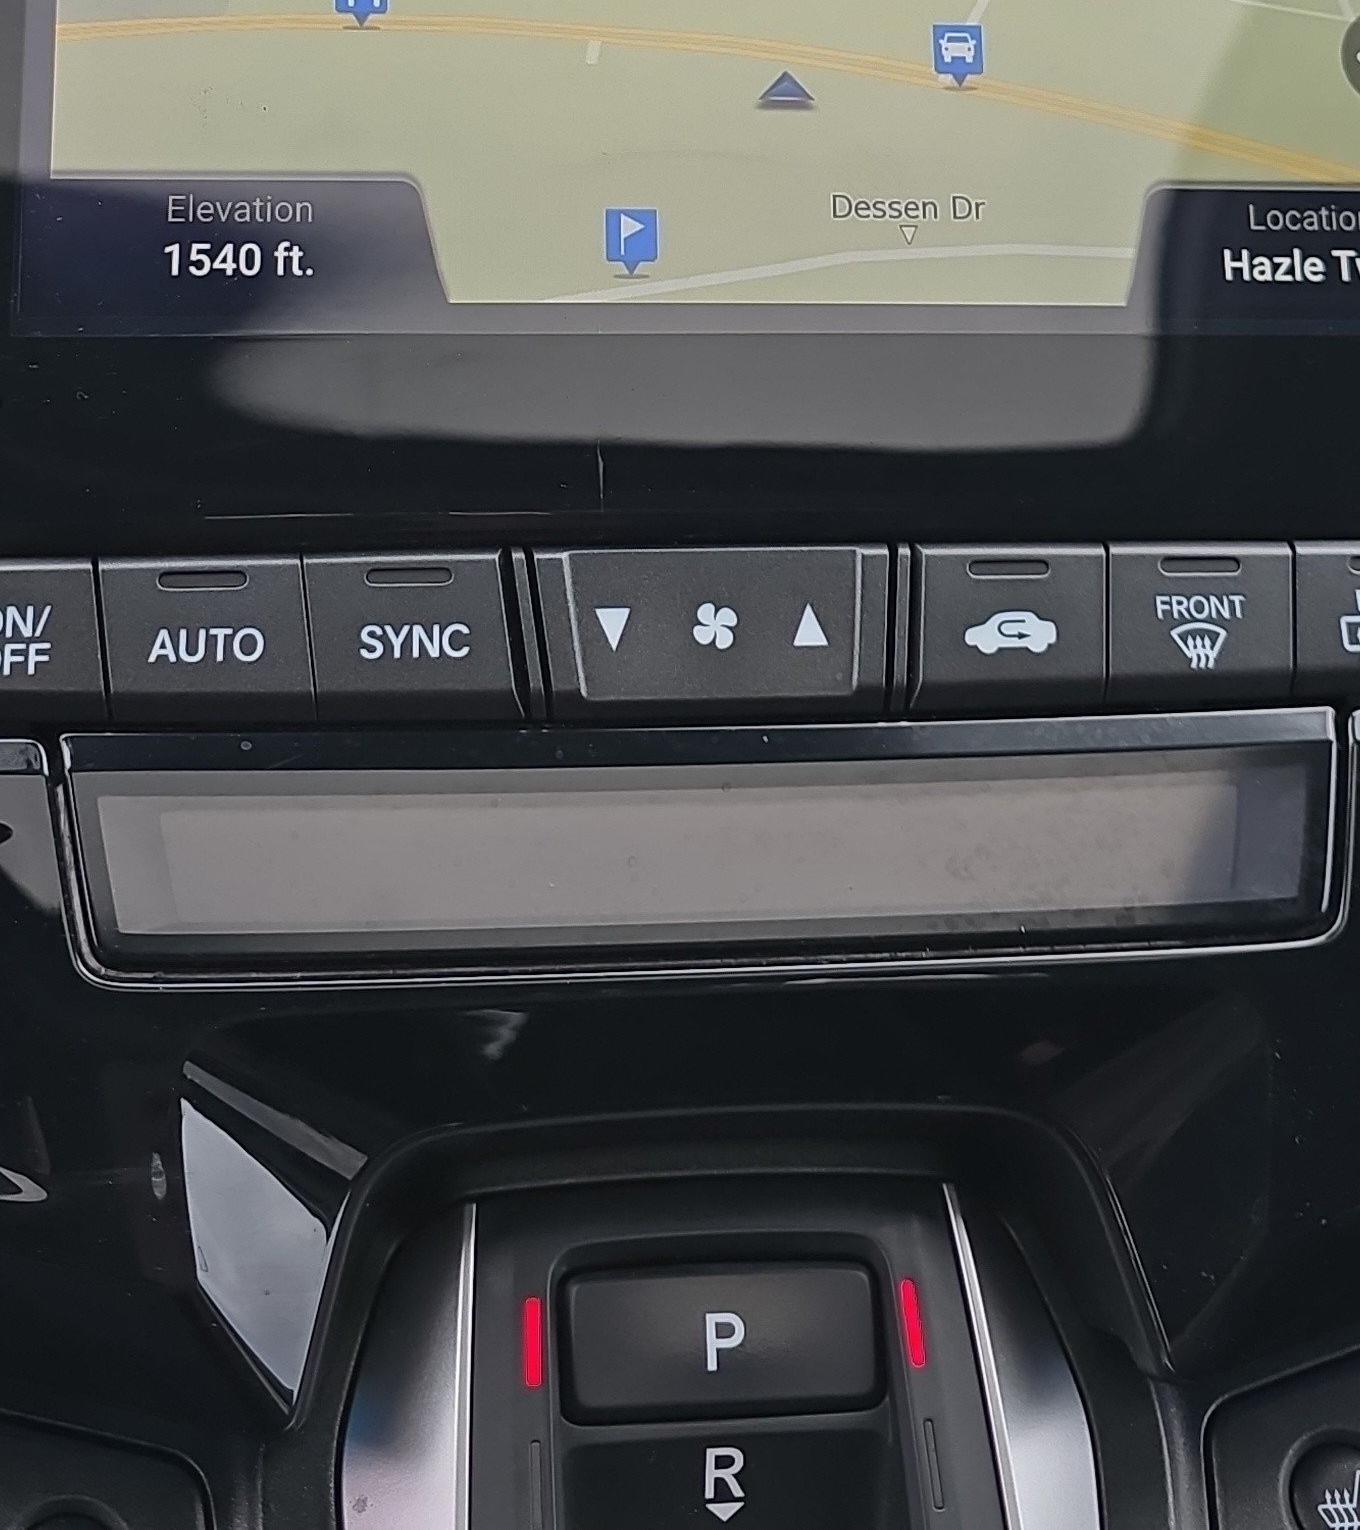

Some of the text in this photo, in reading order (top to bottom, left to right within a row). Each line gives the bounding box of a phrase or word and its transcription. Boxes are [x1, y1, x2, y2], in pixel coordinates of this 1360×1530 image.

[166, 194, 314, 224] Elevation
[830, 192, 986, 223] Dessen Dr
[162, 241, 315, 277] 1540 ft.
[1221, 247, 1325, 283] Hazle
[1155, 592, 1246, 621] FRONT
[147, 626, 266, 664] AUTO
[359, 623, 472, 661] SYNC
[704, 1312, 746, 1372] P
[704, 1446, 746, 1500] R
